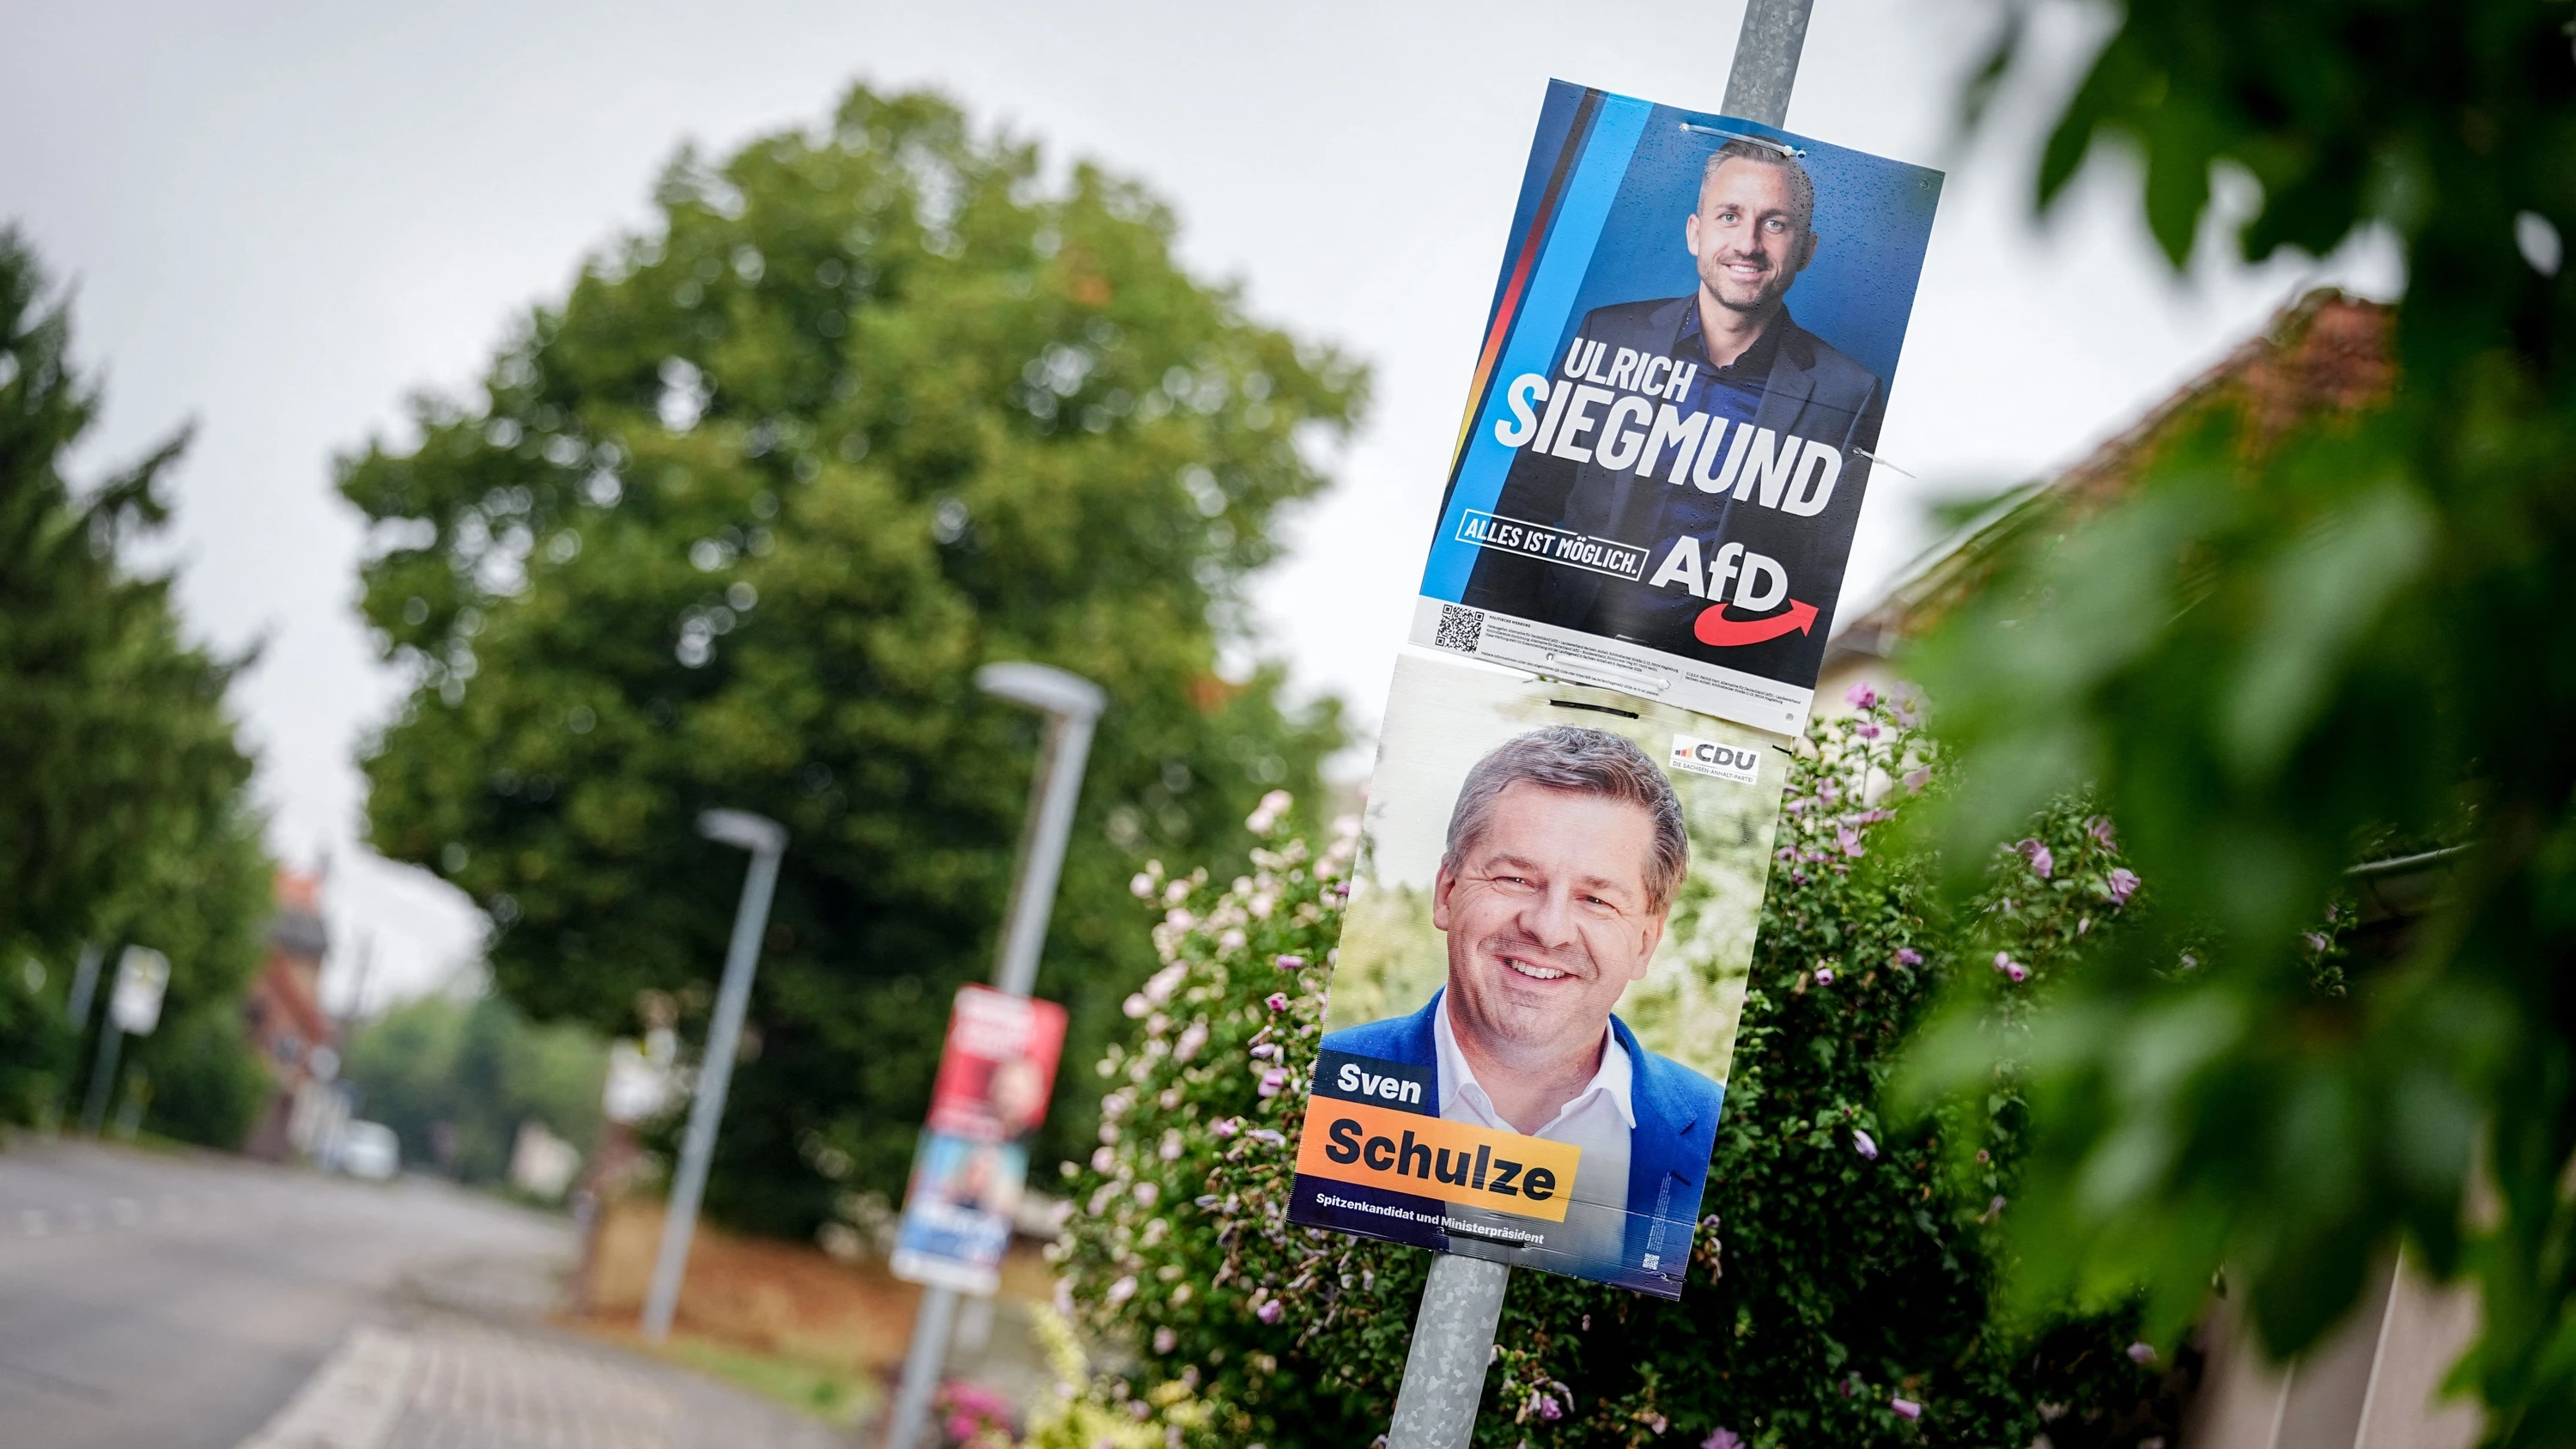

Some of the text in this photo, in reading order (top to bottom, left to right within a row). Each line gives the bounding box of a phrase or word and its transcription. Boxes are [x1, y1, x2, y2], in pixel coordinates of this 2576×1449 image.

[1564, 338, 1697, 402] ULRICH
[1494, 373, 1843, 516] SIEGMUND
[1464, 519, 1637, 574] ALLES IST MÖGLICH.
[1649, 535, 1788, 612] AfD
[1682, 763, 1753, 782] SACHSEN-ANHALT-PARTEI
[1695, 744, 1757, 770] CDU
[1338, 1063, 1421, 1104] Sven
[1325, 1118, 1556, 1201] Schulze
[1316, 1193, 1544, 1245] Spitzenkandidat und Ministerpräsident
